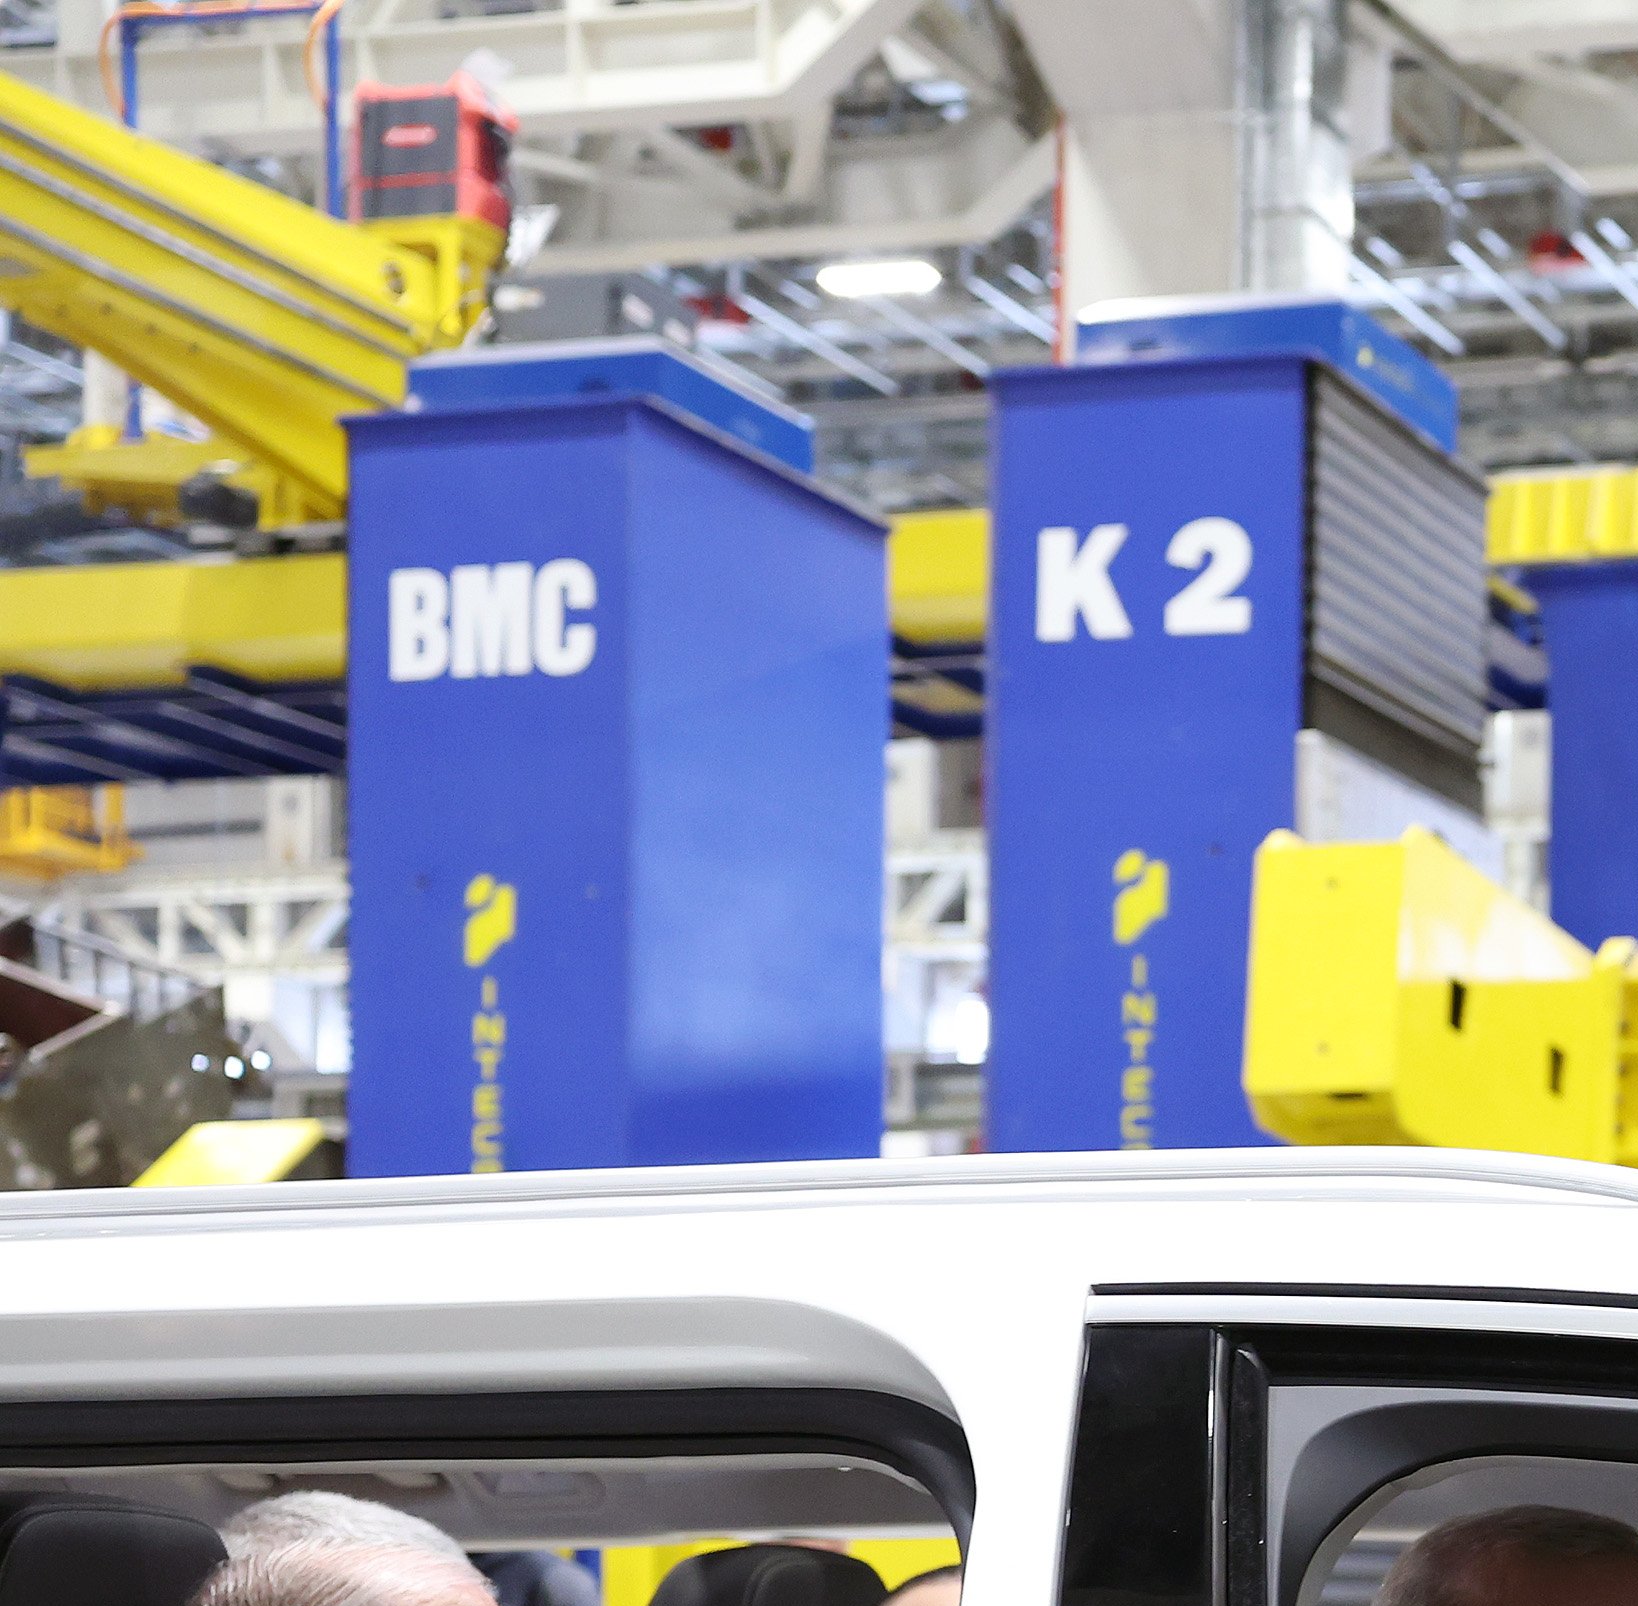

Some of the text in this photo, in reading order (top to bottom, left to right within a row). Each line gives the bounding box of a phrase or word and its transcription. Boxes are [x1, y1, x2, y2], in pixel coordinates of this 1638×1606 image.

[388, 558, 597, 683] BMC
[1034, 517, 1253, 643] K 2
[1120, 953, 1157, 1149] INTEC
